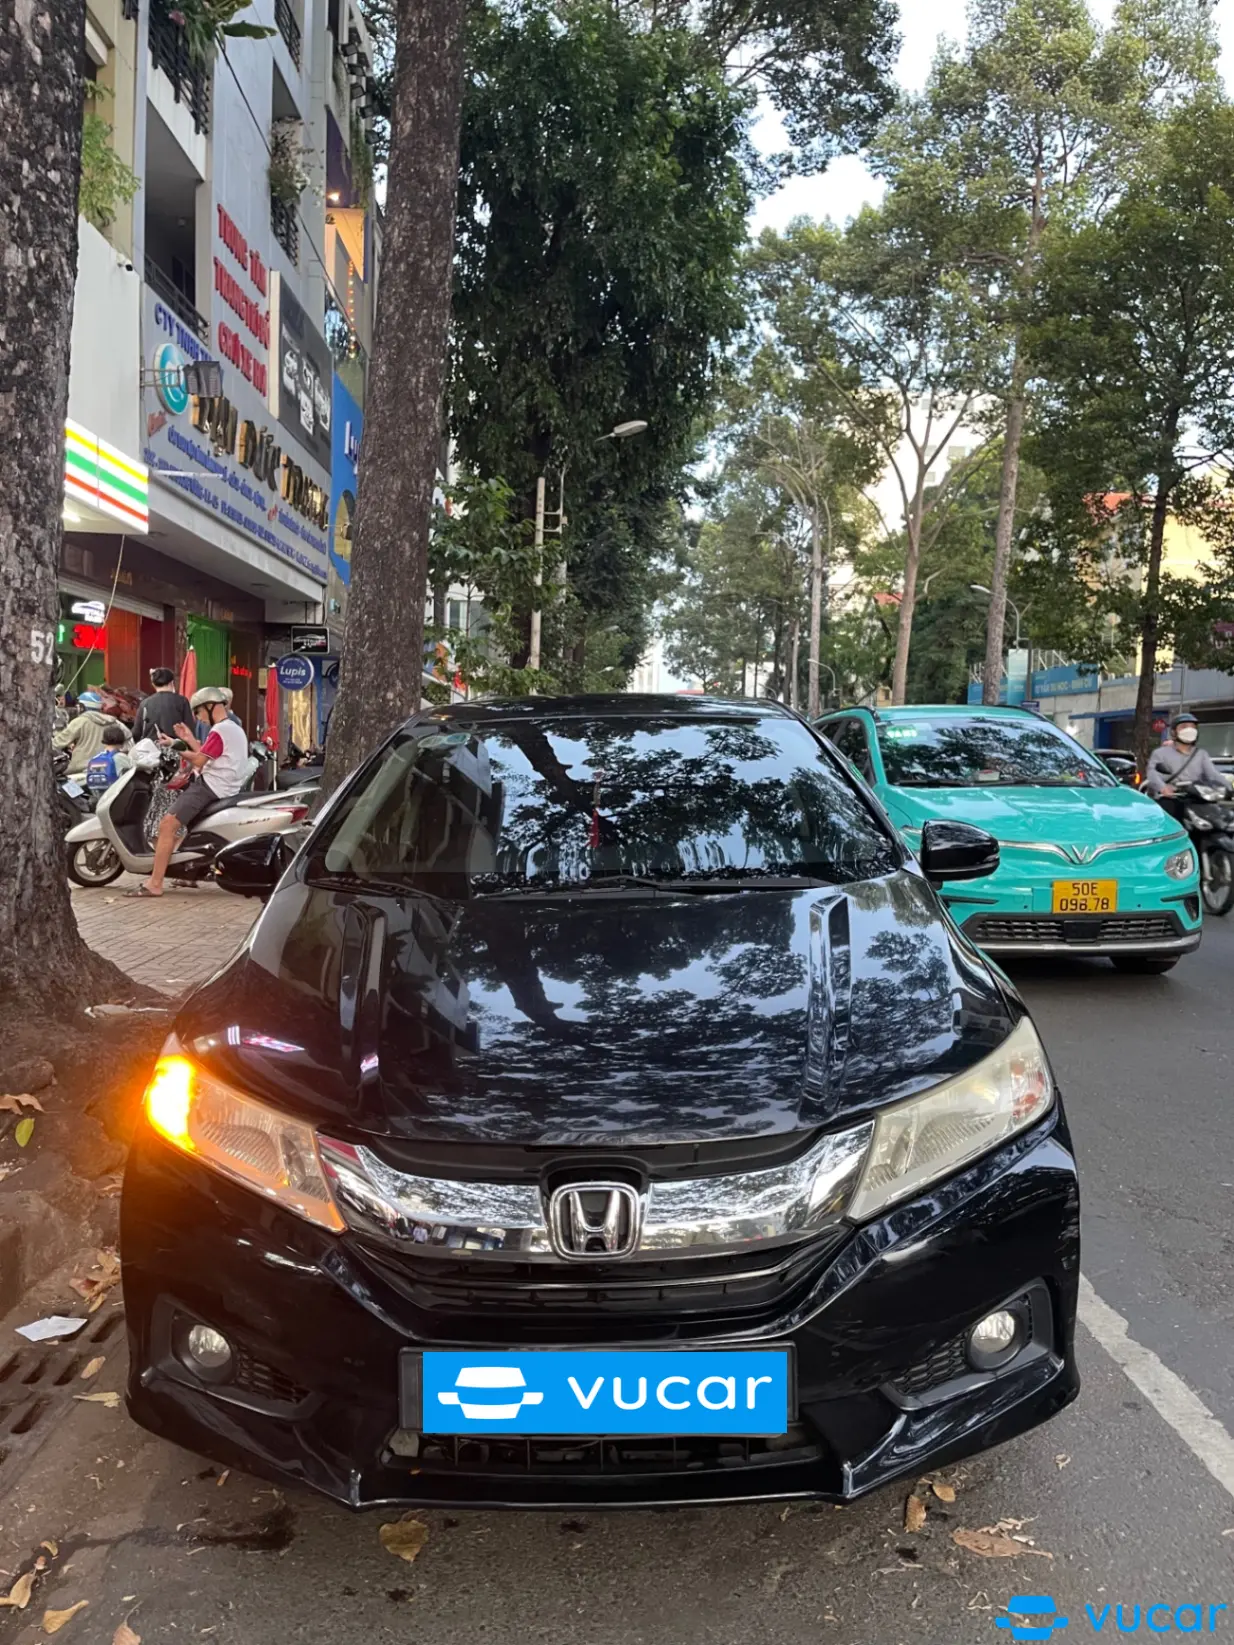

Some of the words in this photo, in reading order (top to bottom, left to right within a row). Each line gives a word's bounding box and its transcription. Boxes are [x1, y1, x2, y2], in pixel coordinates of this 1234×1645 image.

[155, 303, 175, 337] CTY
[279, 666, 306, 678] Lupis
[1072, 882, 1099, 896] 50E
